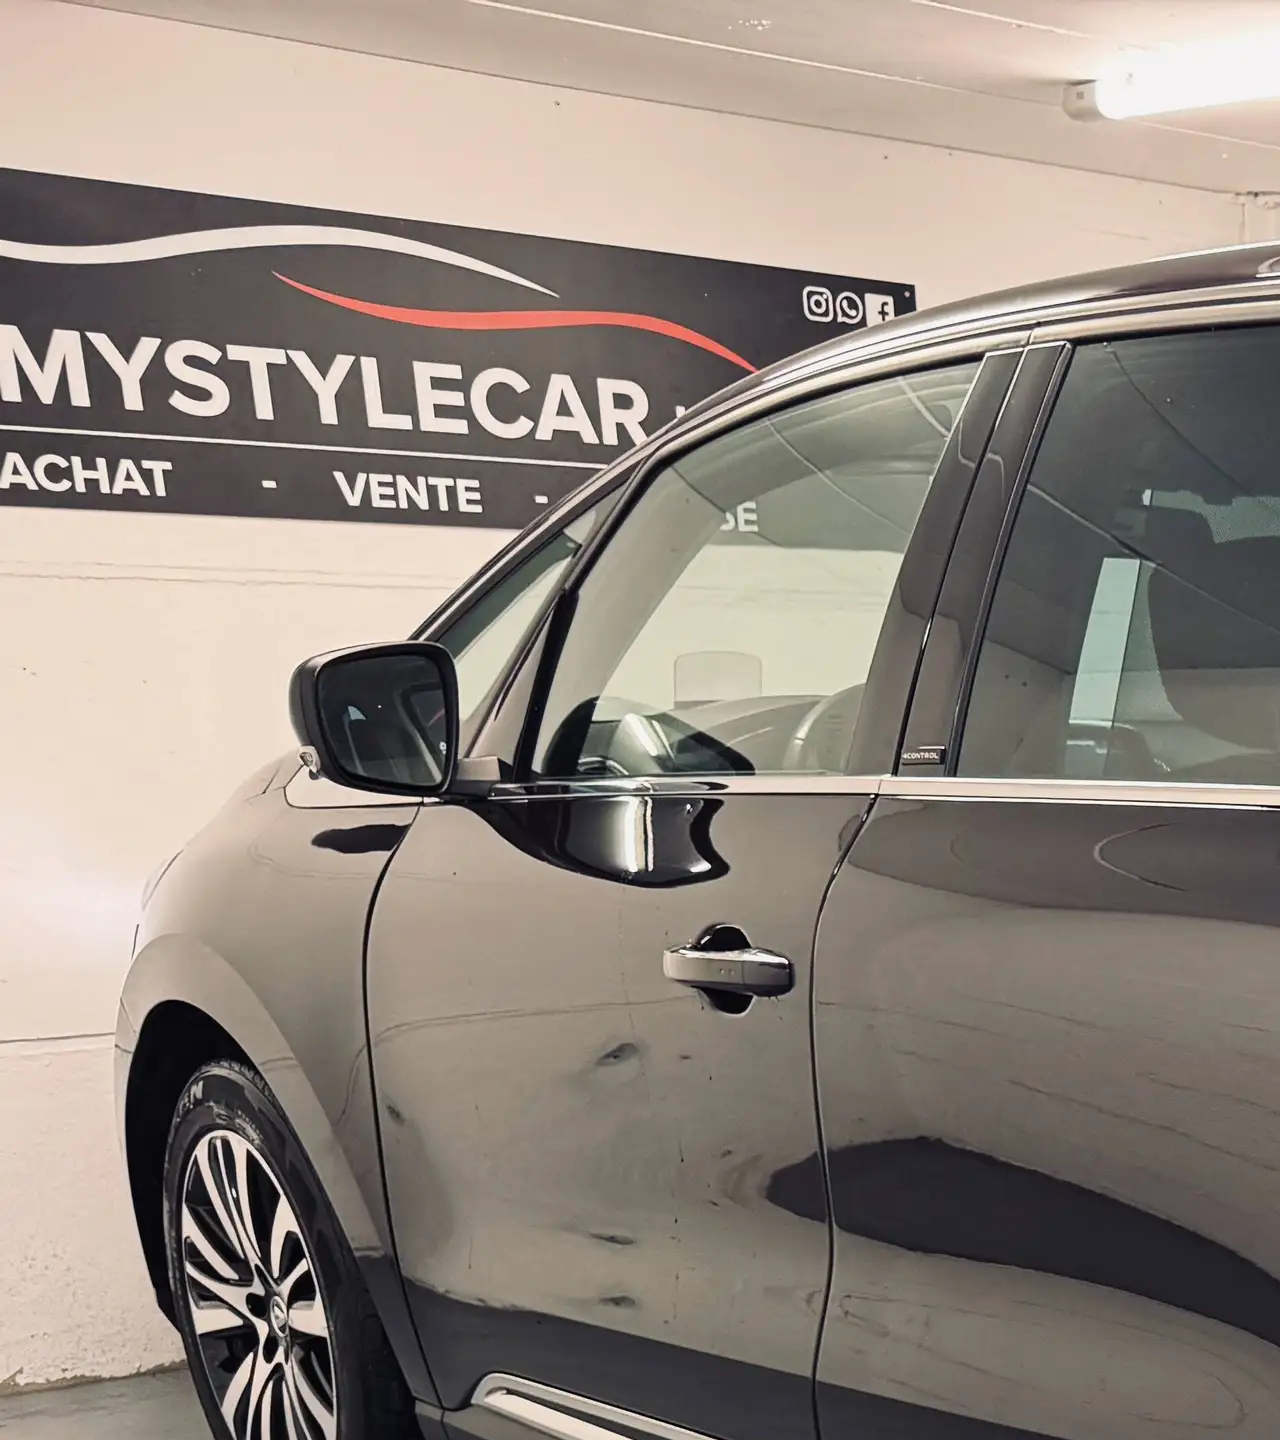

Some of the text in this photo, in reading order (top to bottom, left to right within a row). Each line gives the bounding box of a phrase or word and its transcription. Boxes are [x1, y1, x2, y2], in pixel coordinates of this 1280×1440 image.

[0, 323, 686, 447] MYSTYLECAR
[0, 452, 173, 497] ACHAT
[332, 471, 483, 513] VENTE
